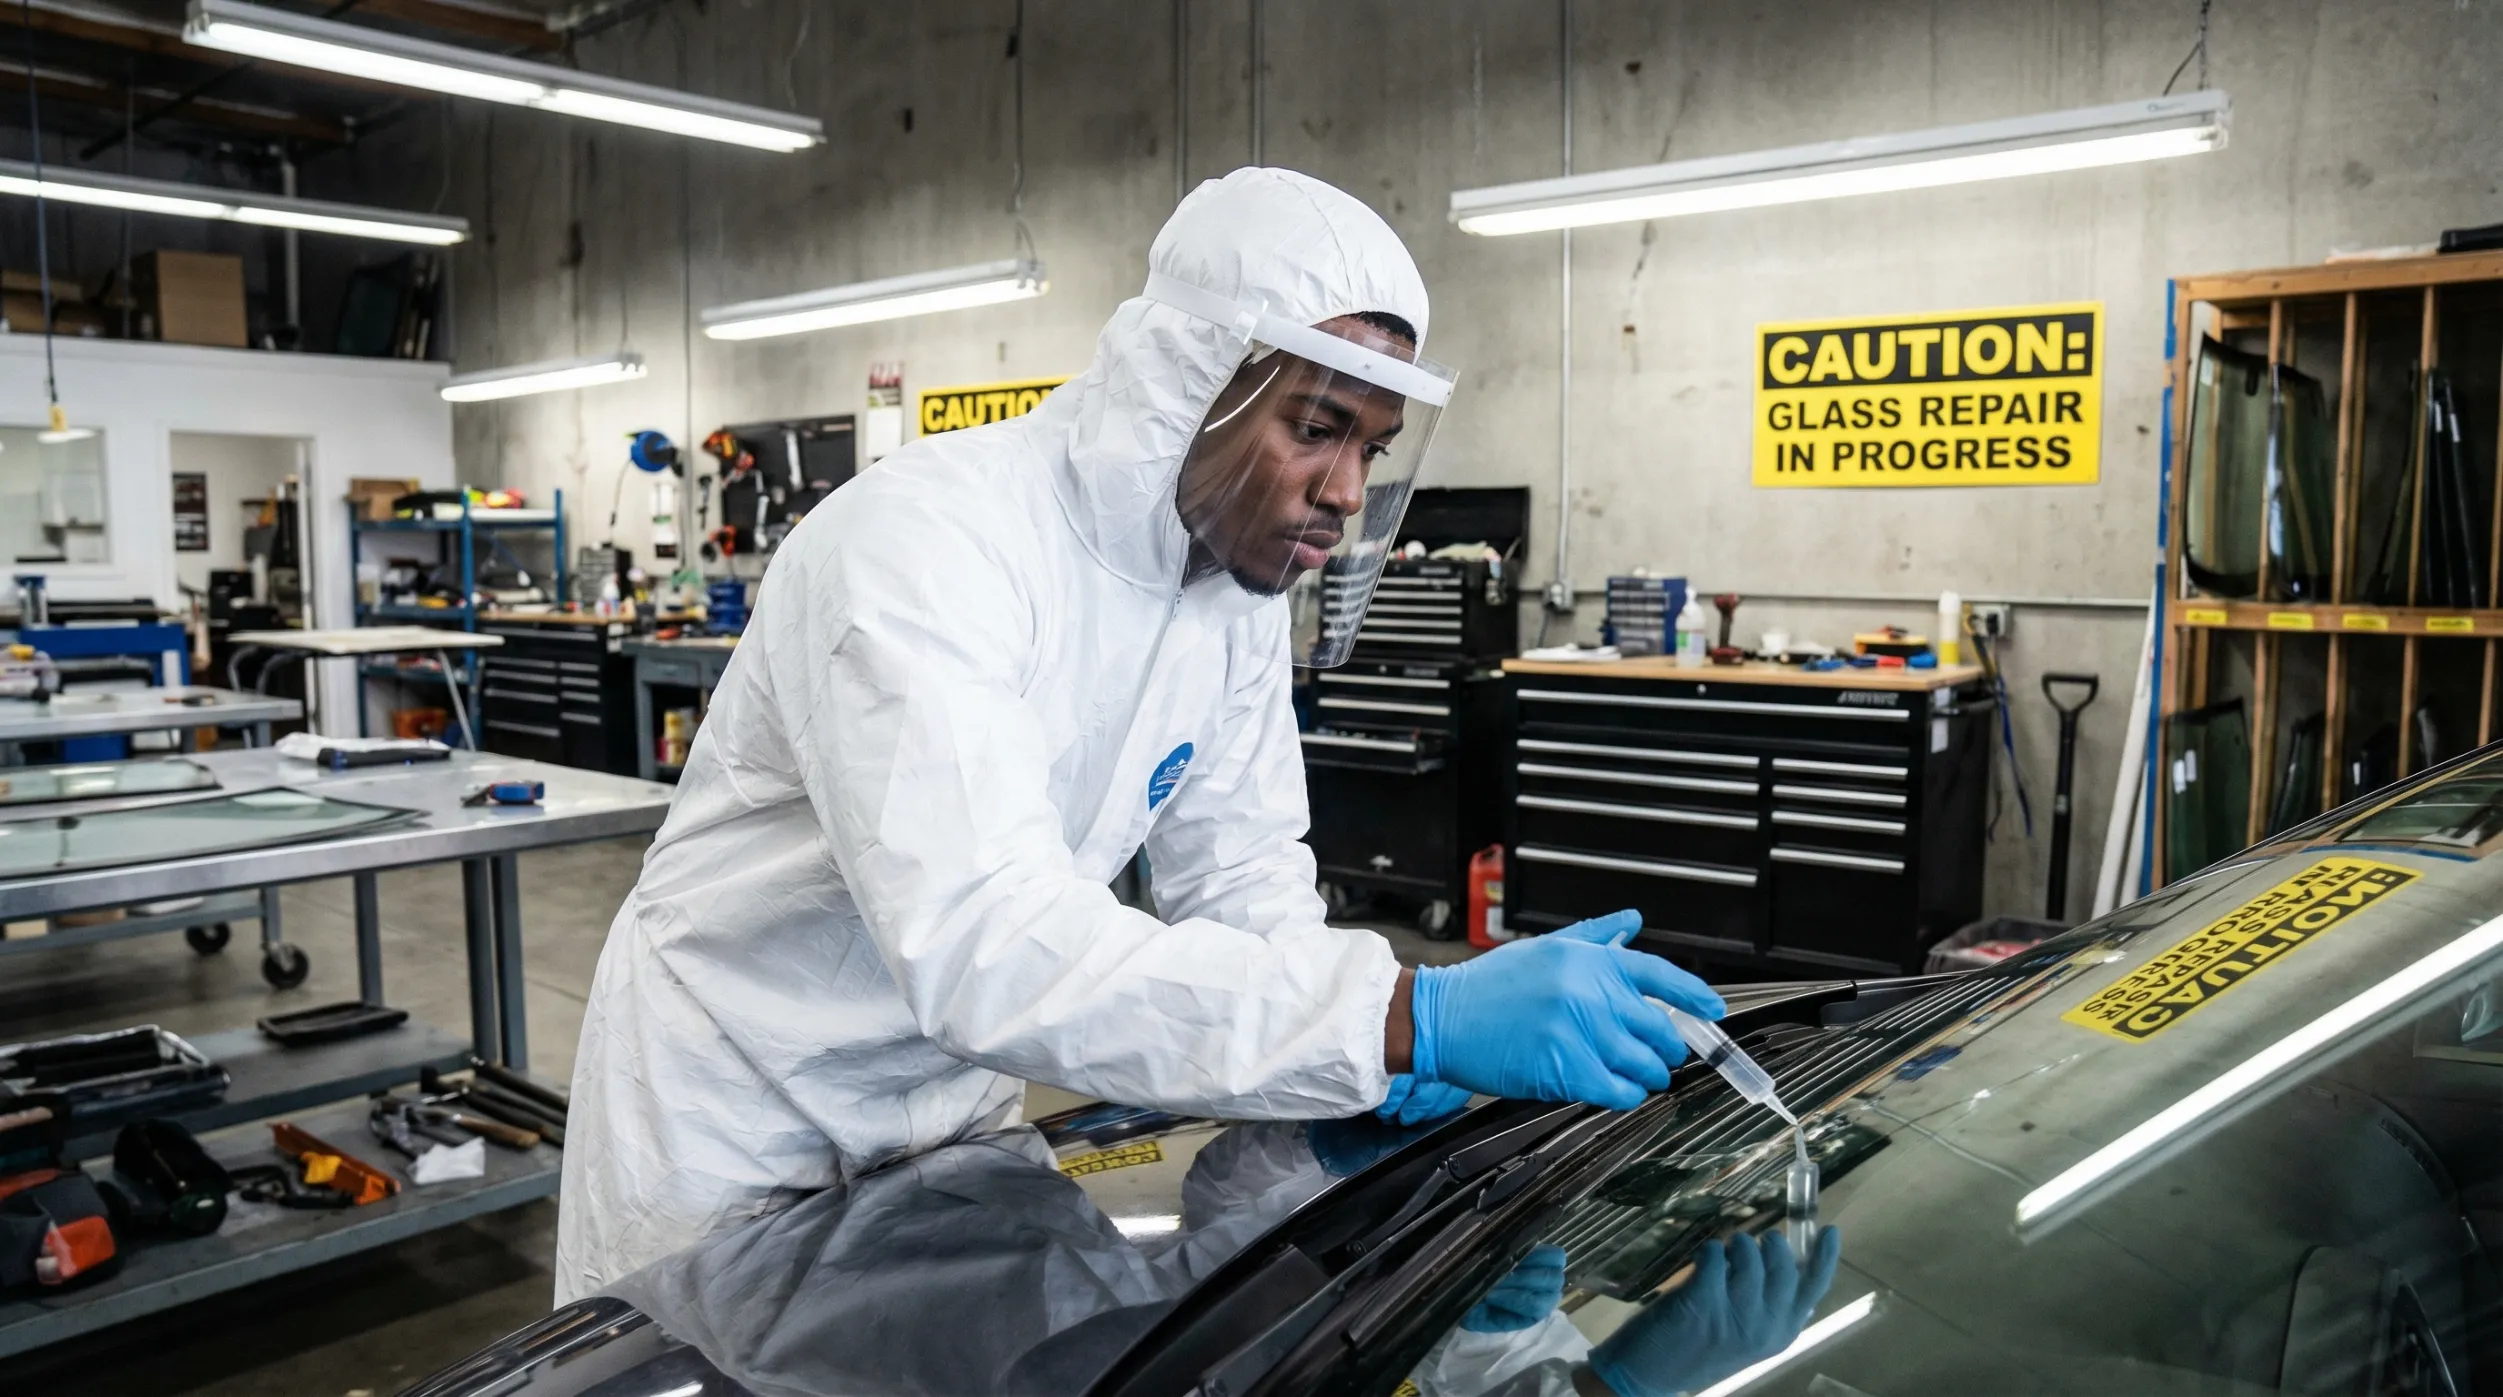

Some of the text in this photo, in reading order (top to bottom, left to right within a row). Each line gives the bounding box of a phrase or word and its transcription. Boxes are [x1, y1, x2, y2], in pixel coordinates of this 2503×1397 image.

[1768, 321, 2087, 384] CAUTION:
[923, 389, 1050, 432] CAUTIO
[1768, 390, 2084, 431] GLASS REPAIR
[1776, 435, 2072, 472] IN PROGRESS
